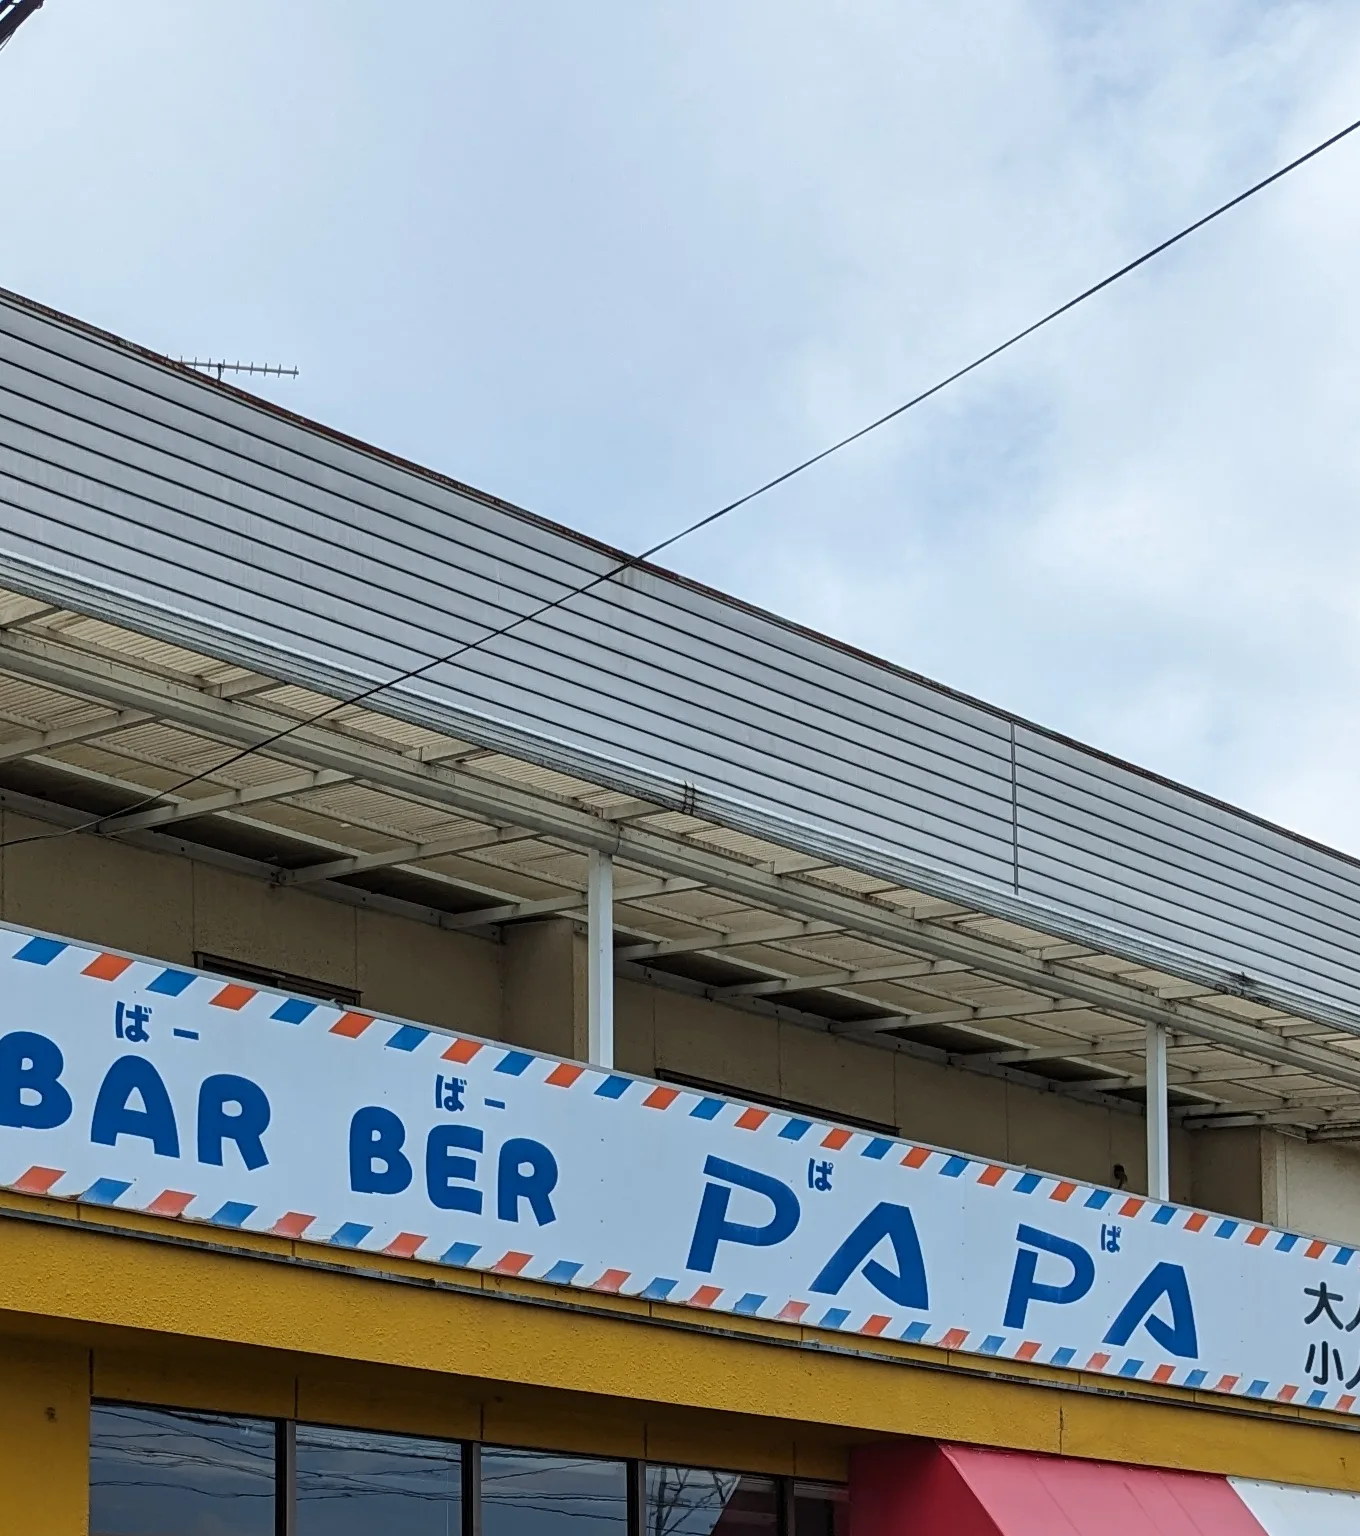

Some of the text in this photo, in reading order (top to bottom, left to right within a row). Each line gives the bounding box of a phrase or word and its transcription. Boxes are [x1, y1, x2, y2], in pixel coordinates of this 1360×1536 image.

[115, 1000, 200, 1043] ばー
[435, 1074, 506, 1112] ばー
[349, 1106, 559, 1227] BER
[808, 1157, 834, 1192] ぱ
[1100, 1223, 1122, 1254] ぱ
